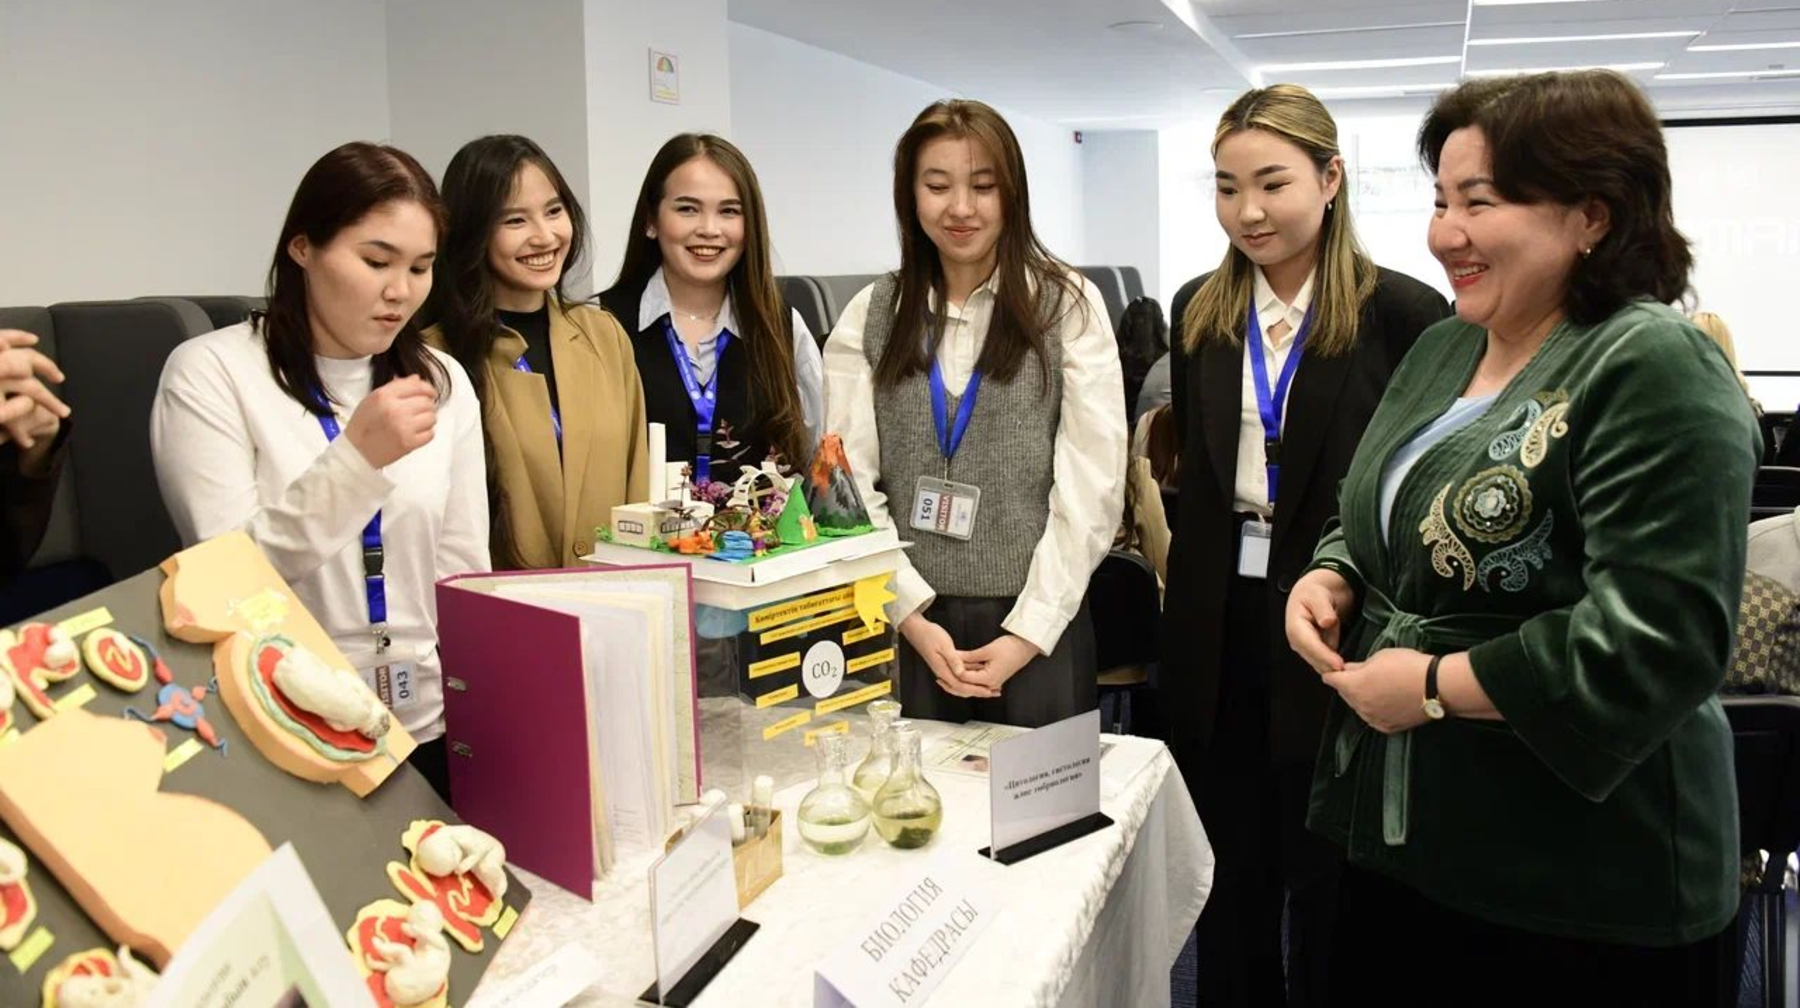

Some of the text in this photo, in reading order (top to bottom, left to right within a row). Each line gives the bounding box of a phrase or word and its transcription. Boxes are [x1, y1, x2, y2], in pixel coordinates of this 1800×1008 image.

[921, 498, 933, 520] 051
[397, 671, 409, 699] 043
[860, 877, 943, 962] БИОЛОГИЯ
[888, 898, 978, 1003] КАФЕДРАСЫ
